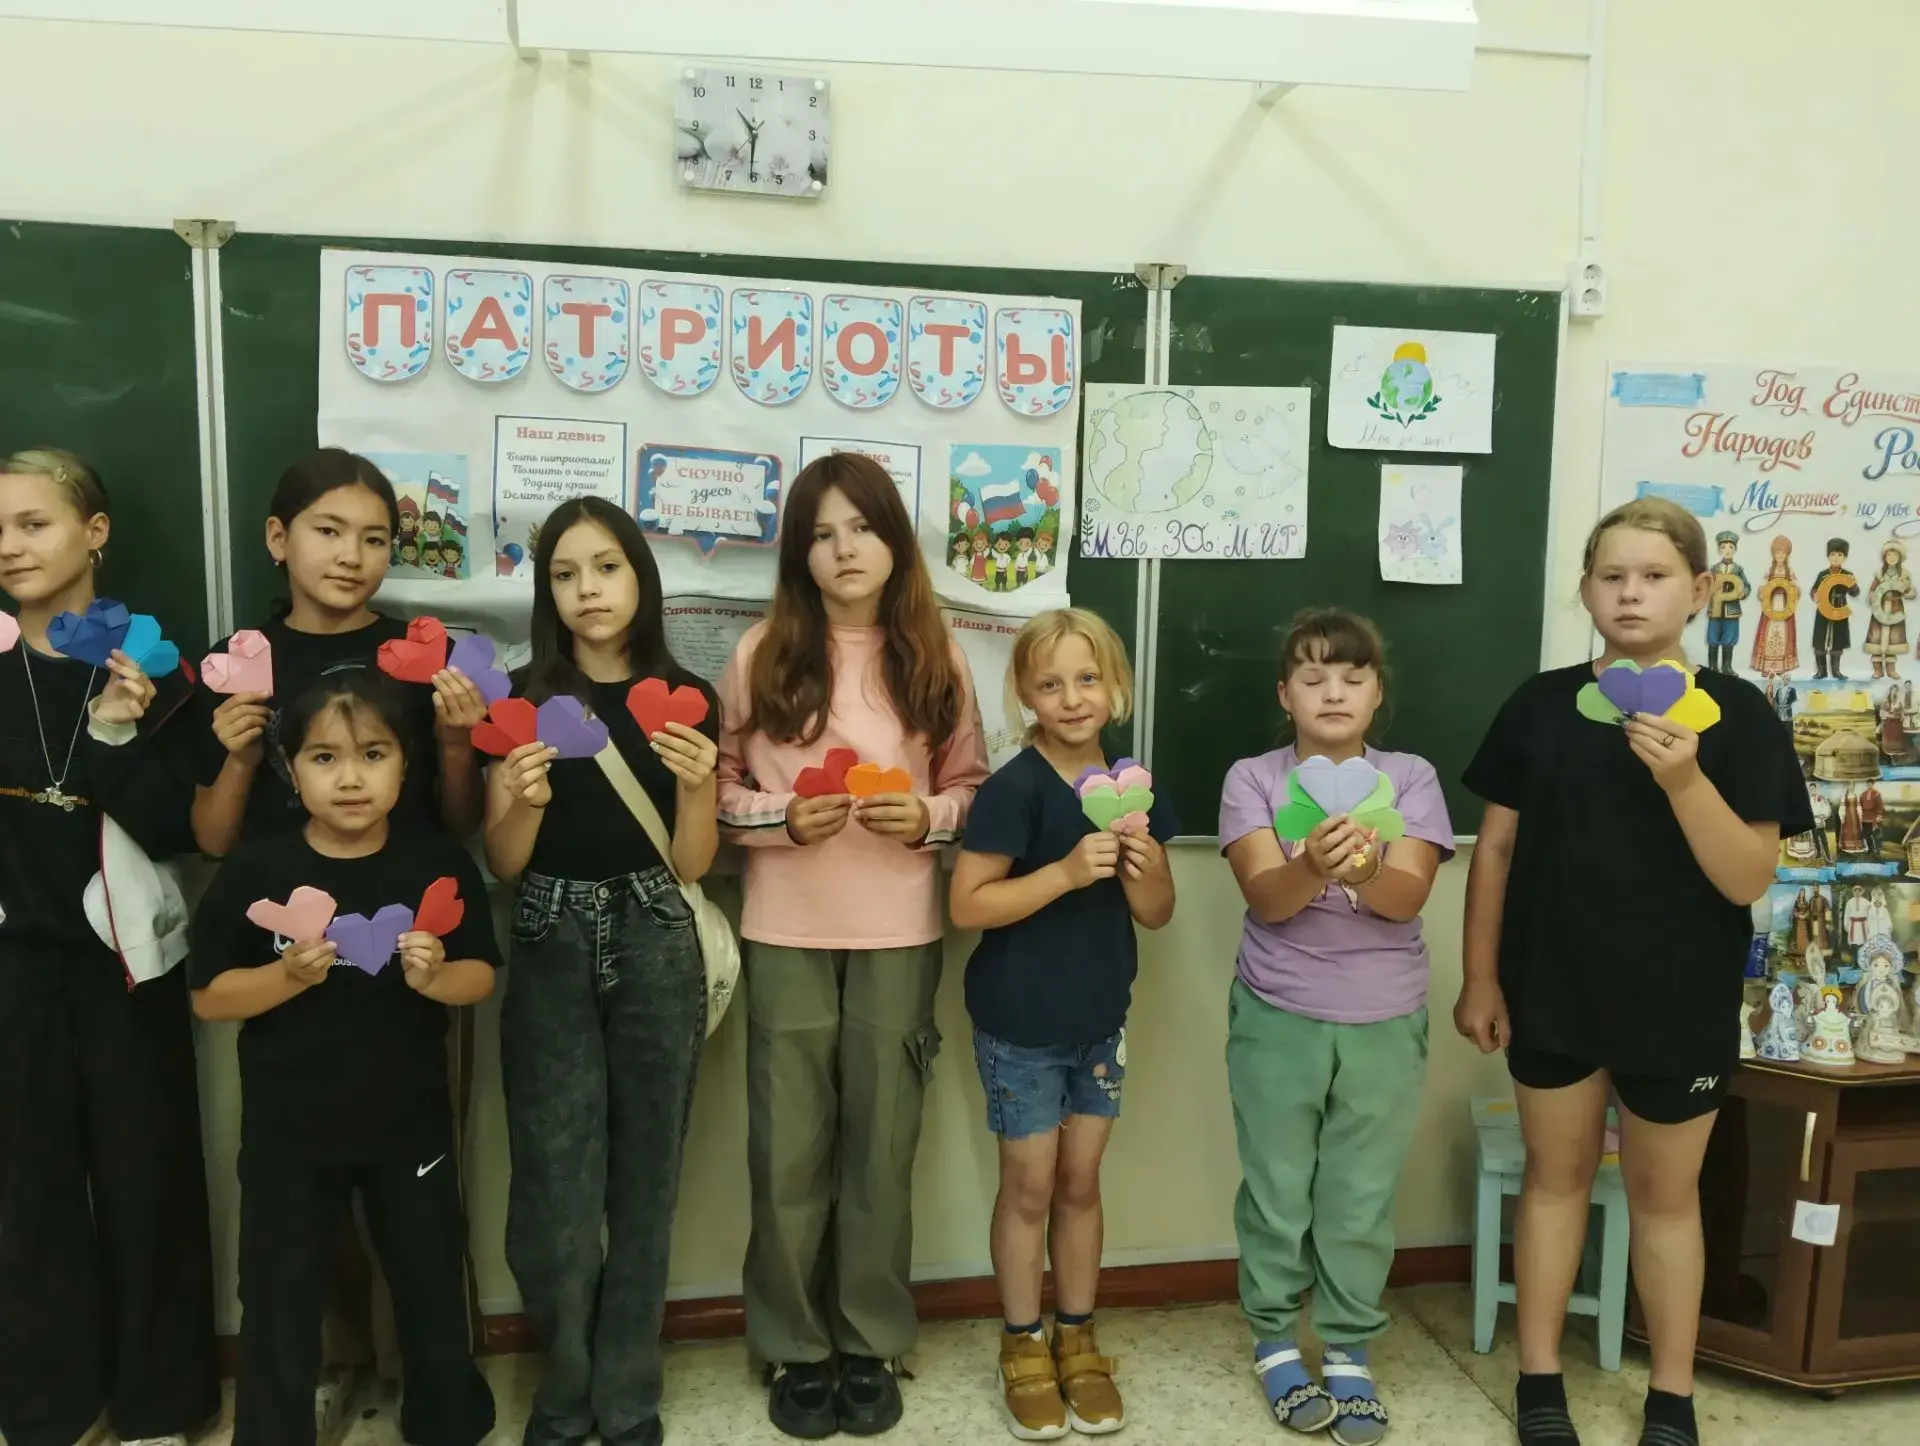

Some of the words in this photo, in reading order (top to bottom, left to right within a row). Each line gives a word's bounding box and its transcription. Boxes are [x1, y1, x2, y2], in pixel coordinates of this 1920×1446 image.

[725, 75, 736, 88] 11
[750, 77, 763, 90] 12
[778, 80, 784, 91] 1
[693, 86, 706, 98] 10
[808, 96, 817, 108] 2
[692, 120, 699, 132] 9
[808, 129, 816, 141] 3
[725, 170, 733, 181] 7
[751, 172, 758, 183] 6
[775, 174, 783, 185] 5
[362, 292, 1066, 387] ПАТРИОТЫ
[1751, 369, 1810, 417] Год
[516, 426, 554, 440] Наш
[557, 431, 606, 443] девиз
[1681, 411, 1816, 473] Народов
[506, 451, 538, 461] Быть
[540, 455, 616, 467] патриотами!
[512, 464, 562, 476] Помнить
[573, 468, 610, 478] чести!
[678, 466, 745, 483] СКУЧНО
[522, 478, 562, 492] Родину
[565, 480, 598, 491] краше
[502, 488, 545, 500] Делать
[690, 486, 733, 505] здесь
[1730, 479, 1779, 515] Мы
[1856, 502, 1877, 517] но
[661, 503, 683, 516] НЕ
[662, 606, 712, 616] Список
[714, 608, 766, 618] отряда
[952, 617, 993, 632] Наша
[997, 625, 1021, 636] пес
